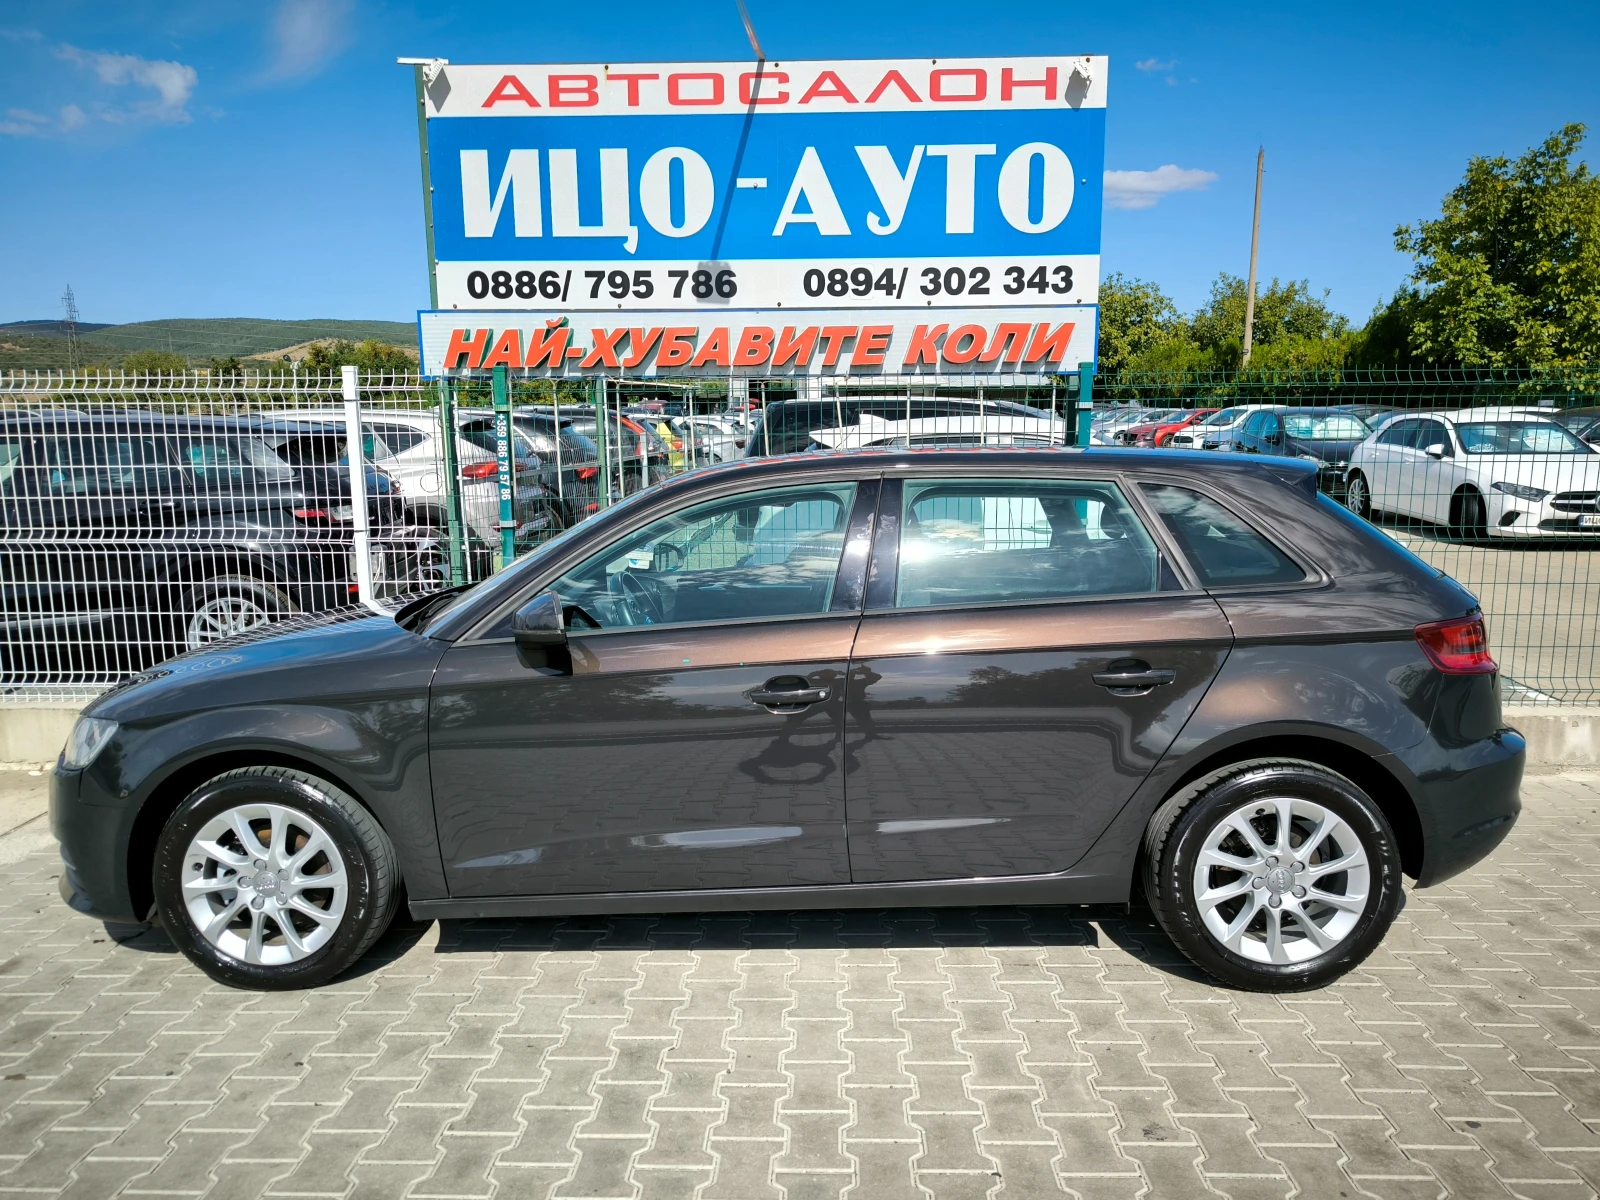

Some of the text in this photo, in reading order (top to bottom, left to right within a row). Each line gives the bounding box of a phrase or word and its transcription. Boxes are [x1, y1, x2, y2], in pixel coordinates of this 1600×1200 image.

[481, 66, 1058, 108] АВТОСАЛОН
[466, 269, 738, 303] 0886/ 795 786
[803, 265, 1073, 300] 0894/ 302 343
[443, 316, 1076, 369] НАЙ-ХУБАВИТЕ КОЛИ
[497, 414, 510, 500] +359 886 79 57 86
